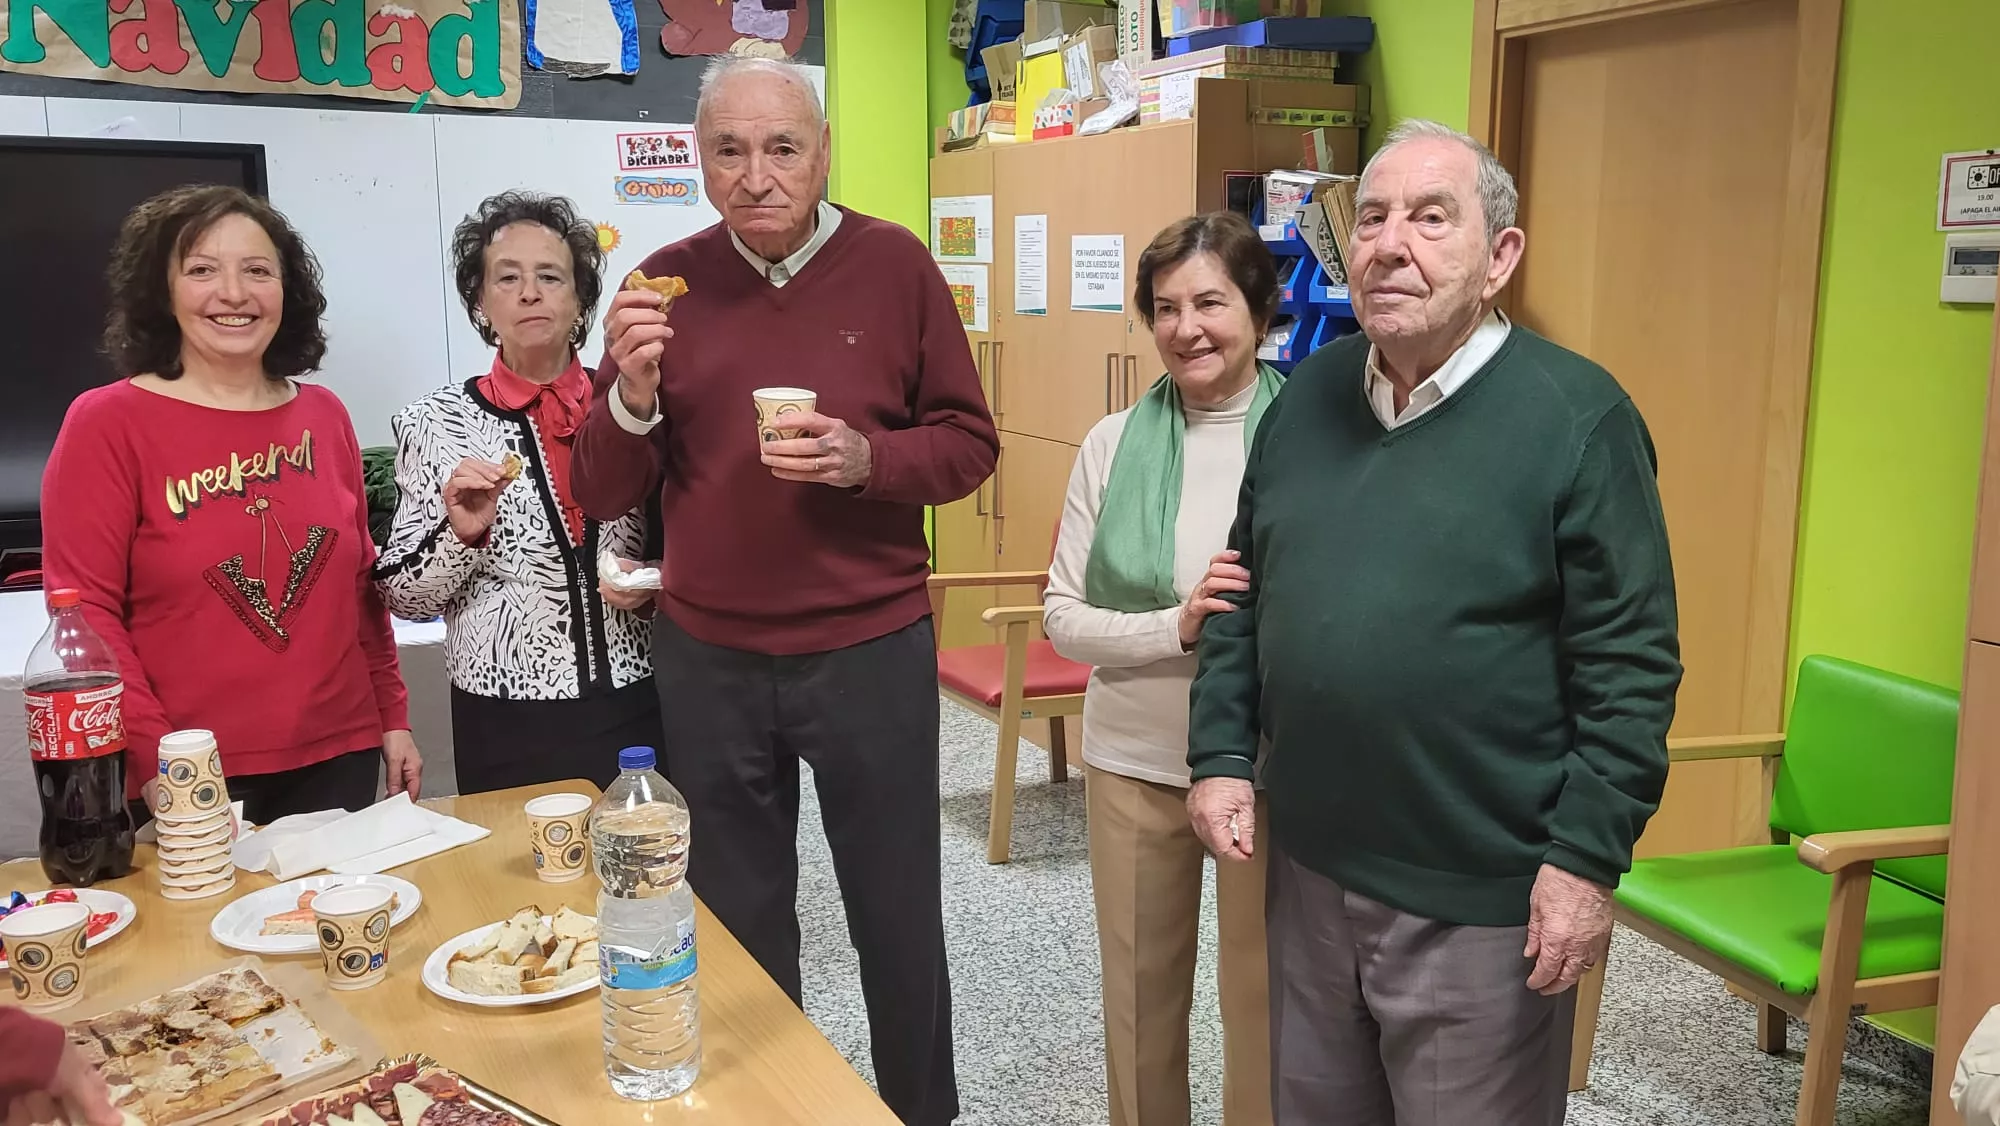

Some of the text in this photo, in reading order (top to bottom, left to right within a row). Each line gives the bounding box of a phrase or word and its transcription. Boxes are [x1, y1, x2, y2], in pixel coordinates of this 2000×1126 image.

[1130, 11, 1138, 52] LOTO
[627, 154, 690, 166] DICIEMBRE
[624, 180, 689, 198] OTOÑO
[1075, 249, 1083, 257] POR
[1083, 249, 1096, 257] FAVOR
[1096, 249, 1113, 257] CUANDO
[1087, 282, 1105, 291] ESTABAN
[80, 690, 113, 701] AHORRO
